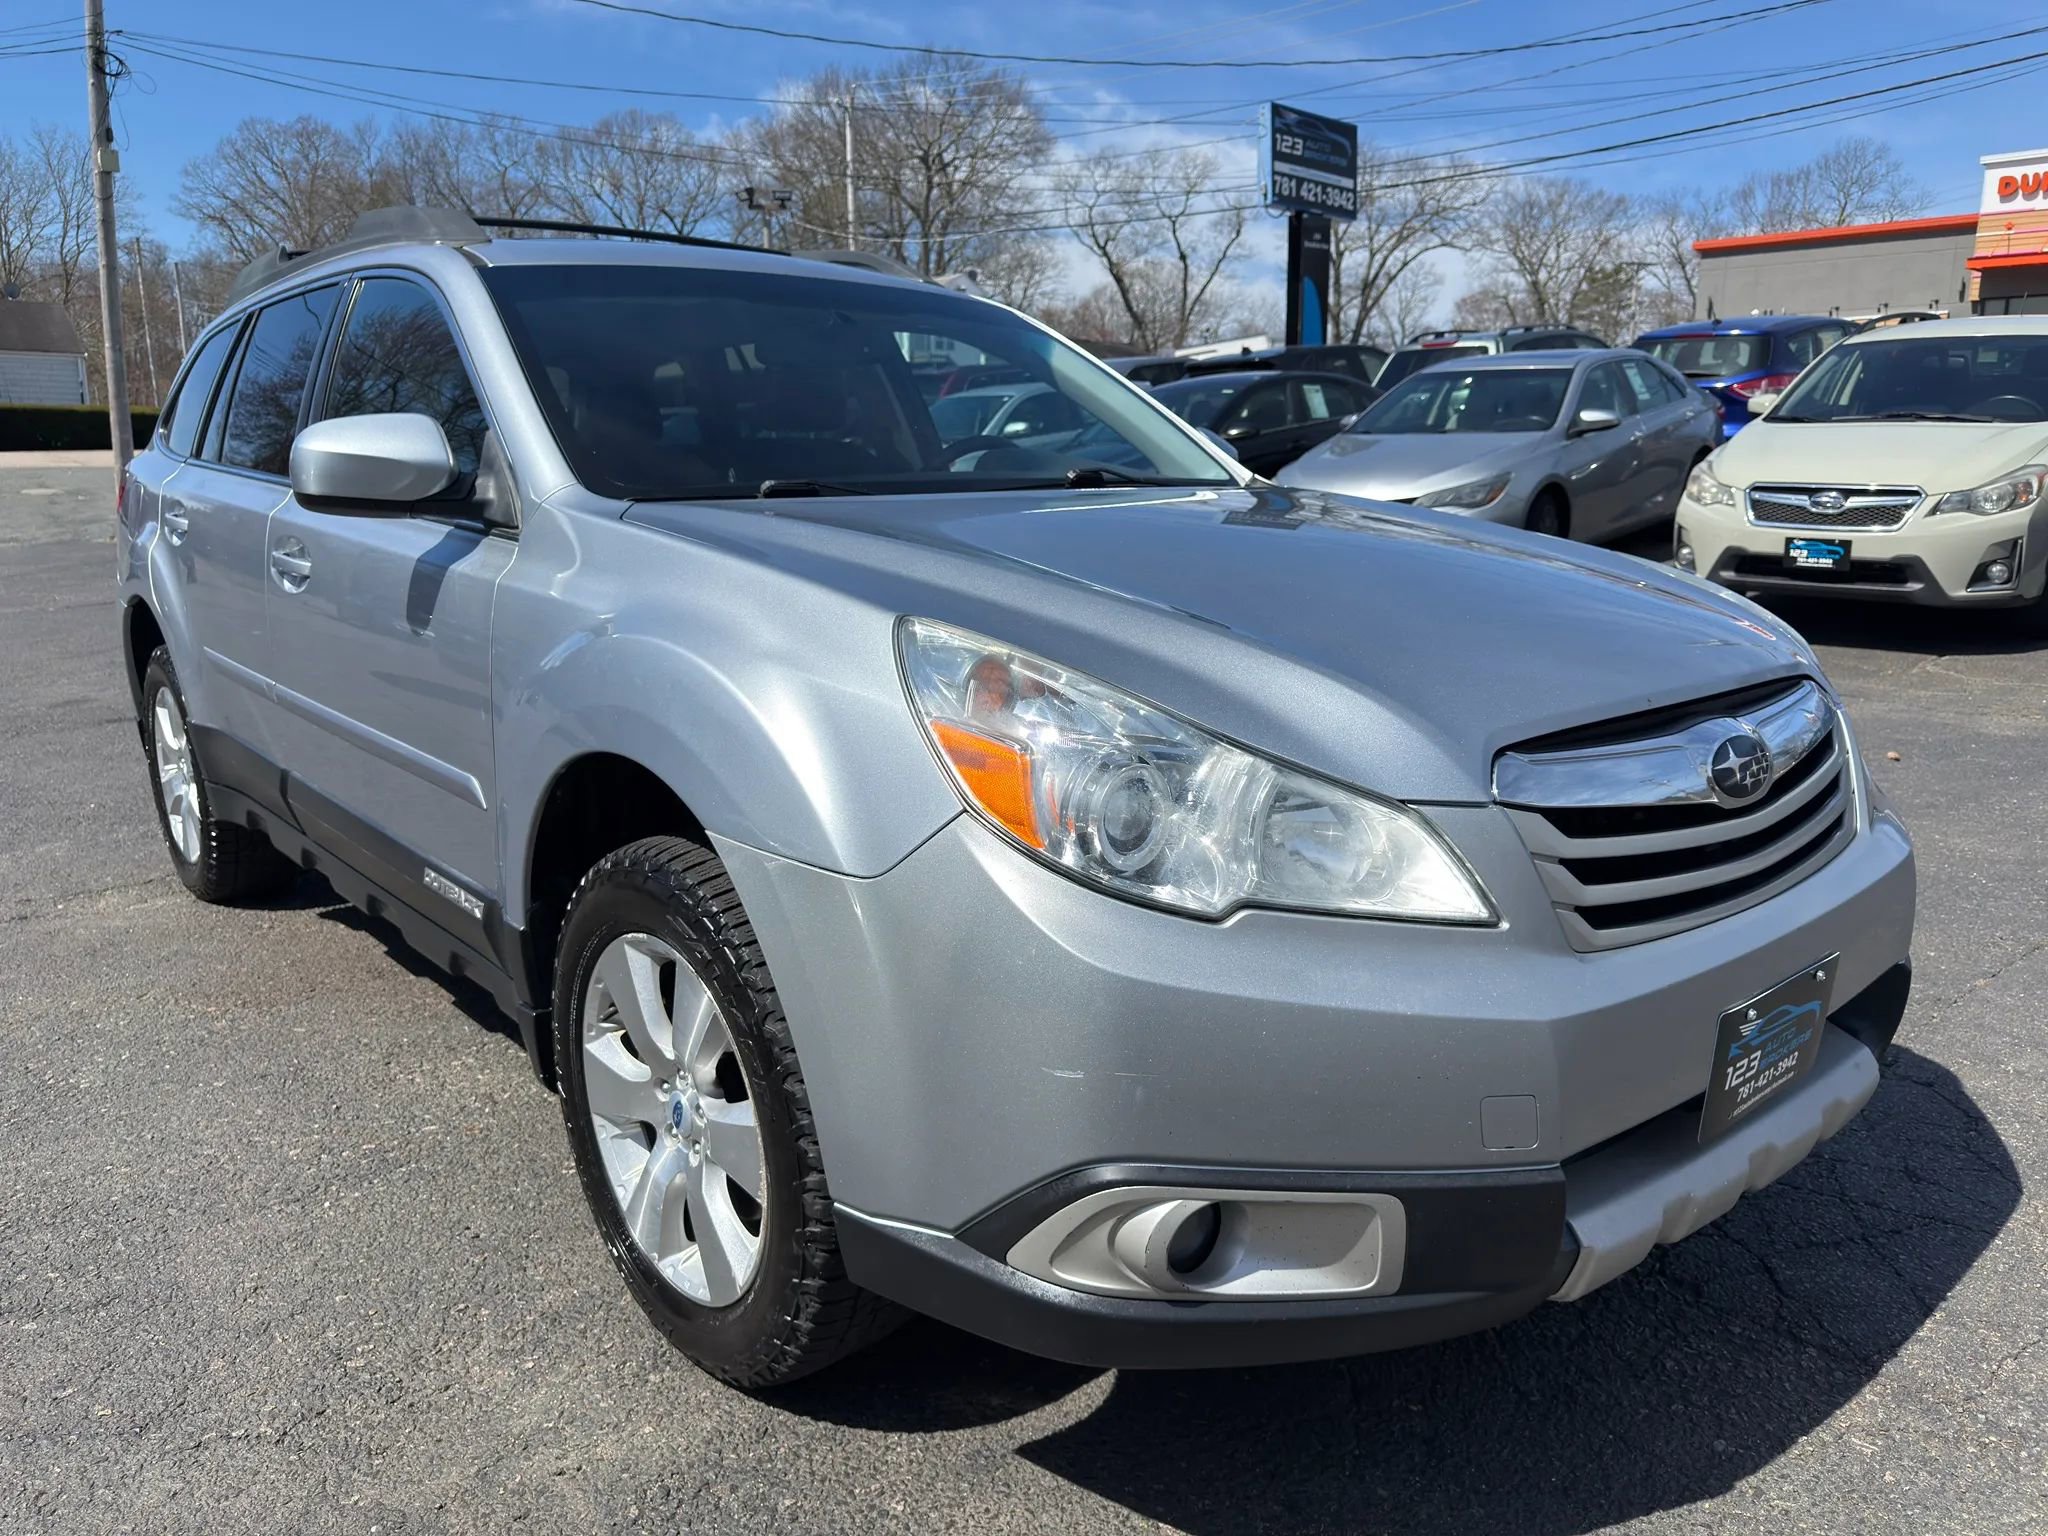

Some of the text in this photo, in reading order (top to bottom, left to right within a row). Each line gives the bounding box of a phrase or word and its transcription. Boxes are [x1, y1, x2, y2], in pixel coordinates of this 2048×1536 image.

[1276, 133, 1303, 155] 123
[1274, 175, 1297, 197] 781
[1725, 1050, 1761, 1091] 123
[1737, 1051, 1798, 1102] 781-421-3942
